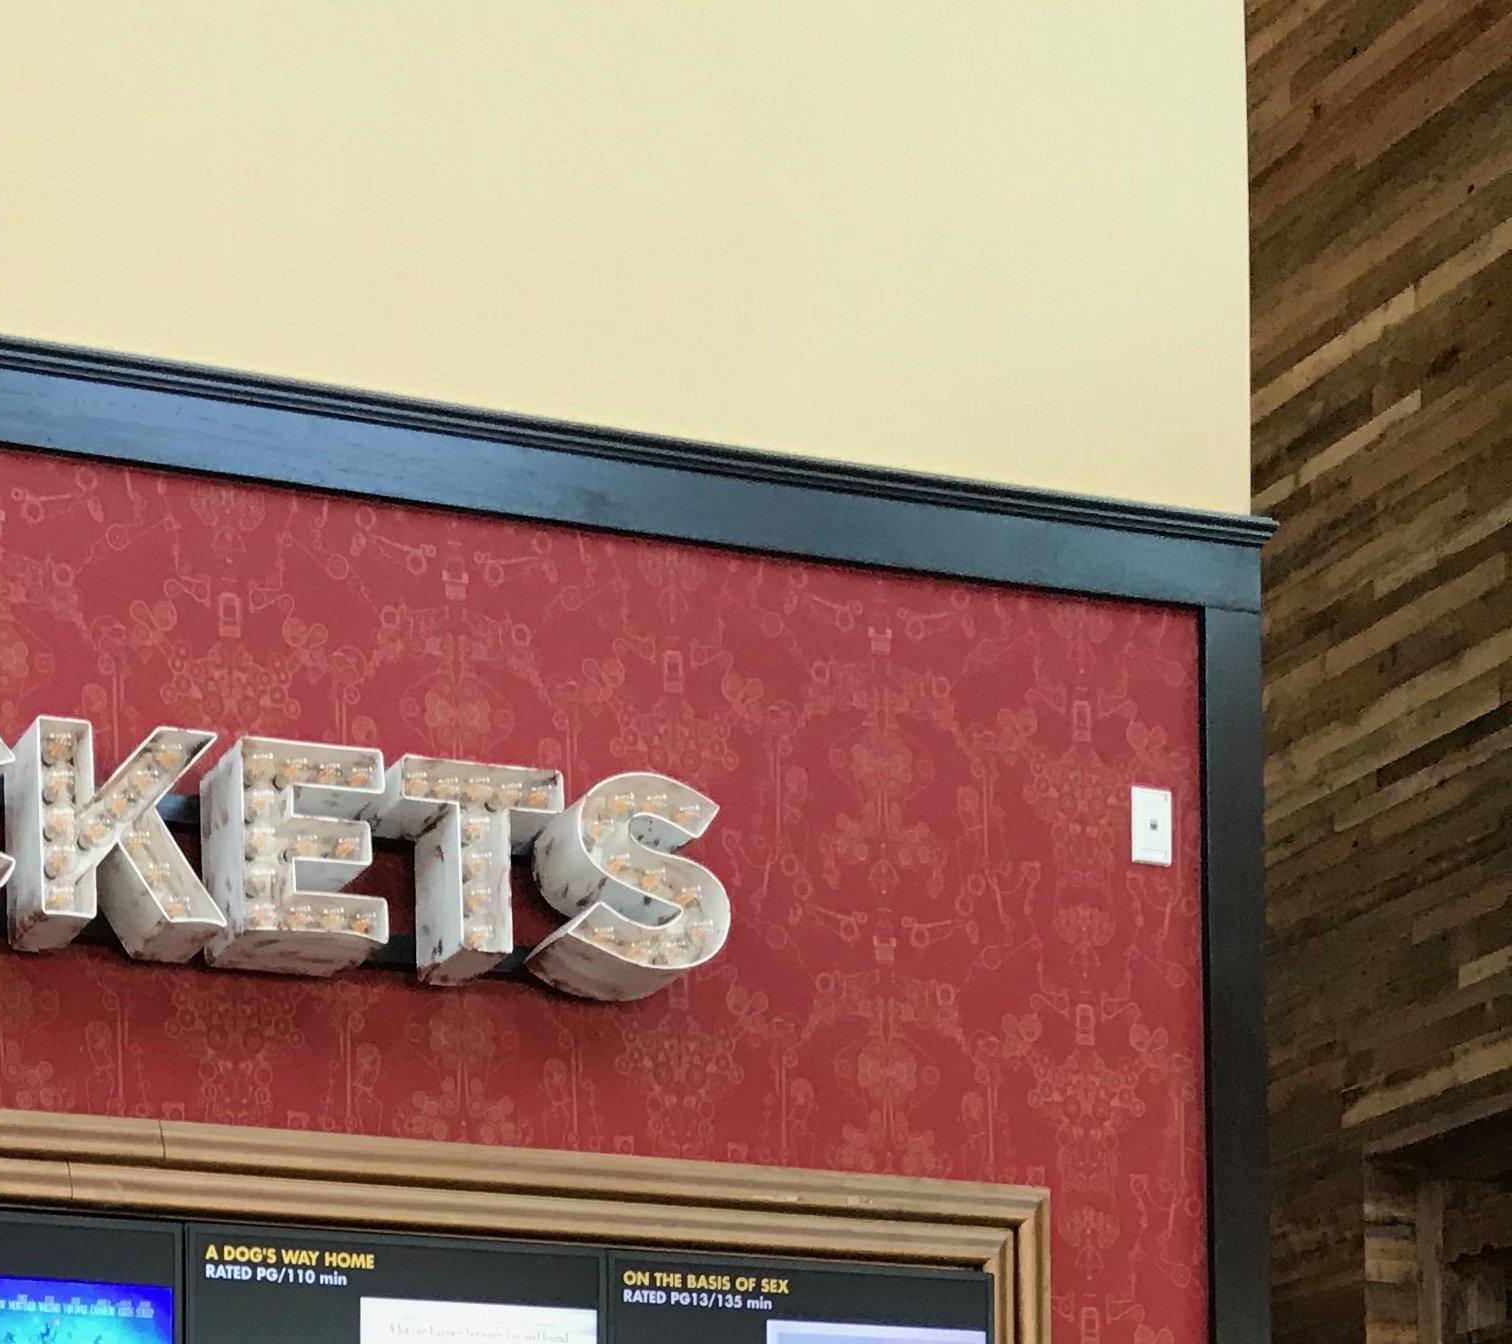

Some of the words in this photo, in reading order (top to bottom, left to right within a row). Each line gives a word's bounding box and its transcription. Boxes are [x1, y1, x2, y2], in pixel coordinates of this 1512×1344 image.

[206, 1245, 218, 1260] A
[223, 1246, 276, 1265] DOG'S
[281, 1250, 319, 1267] WAY
[324, 1254, 374, 1269] HOME
[205, 1265, 252, 1281] RATED
[257, 1268, 315, 1286] PG/110
[320, 1272, 347, 1286] min
[623, 1271, 650, 1287] ON
[654, 1272, 682, 1288] THE
[687, 1275, 731, 1291] BASIS
[736, 1277, 756, 1291] OF
[760, 1278, 789, 1294] SEX
[623, 1289, 667, 1305] RATED
[670, 1292, 741, 1309] PG13/135
[747, 1296, 772, 1310] min
